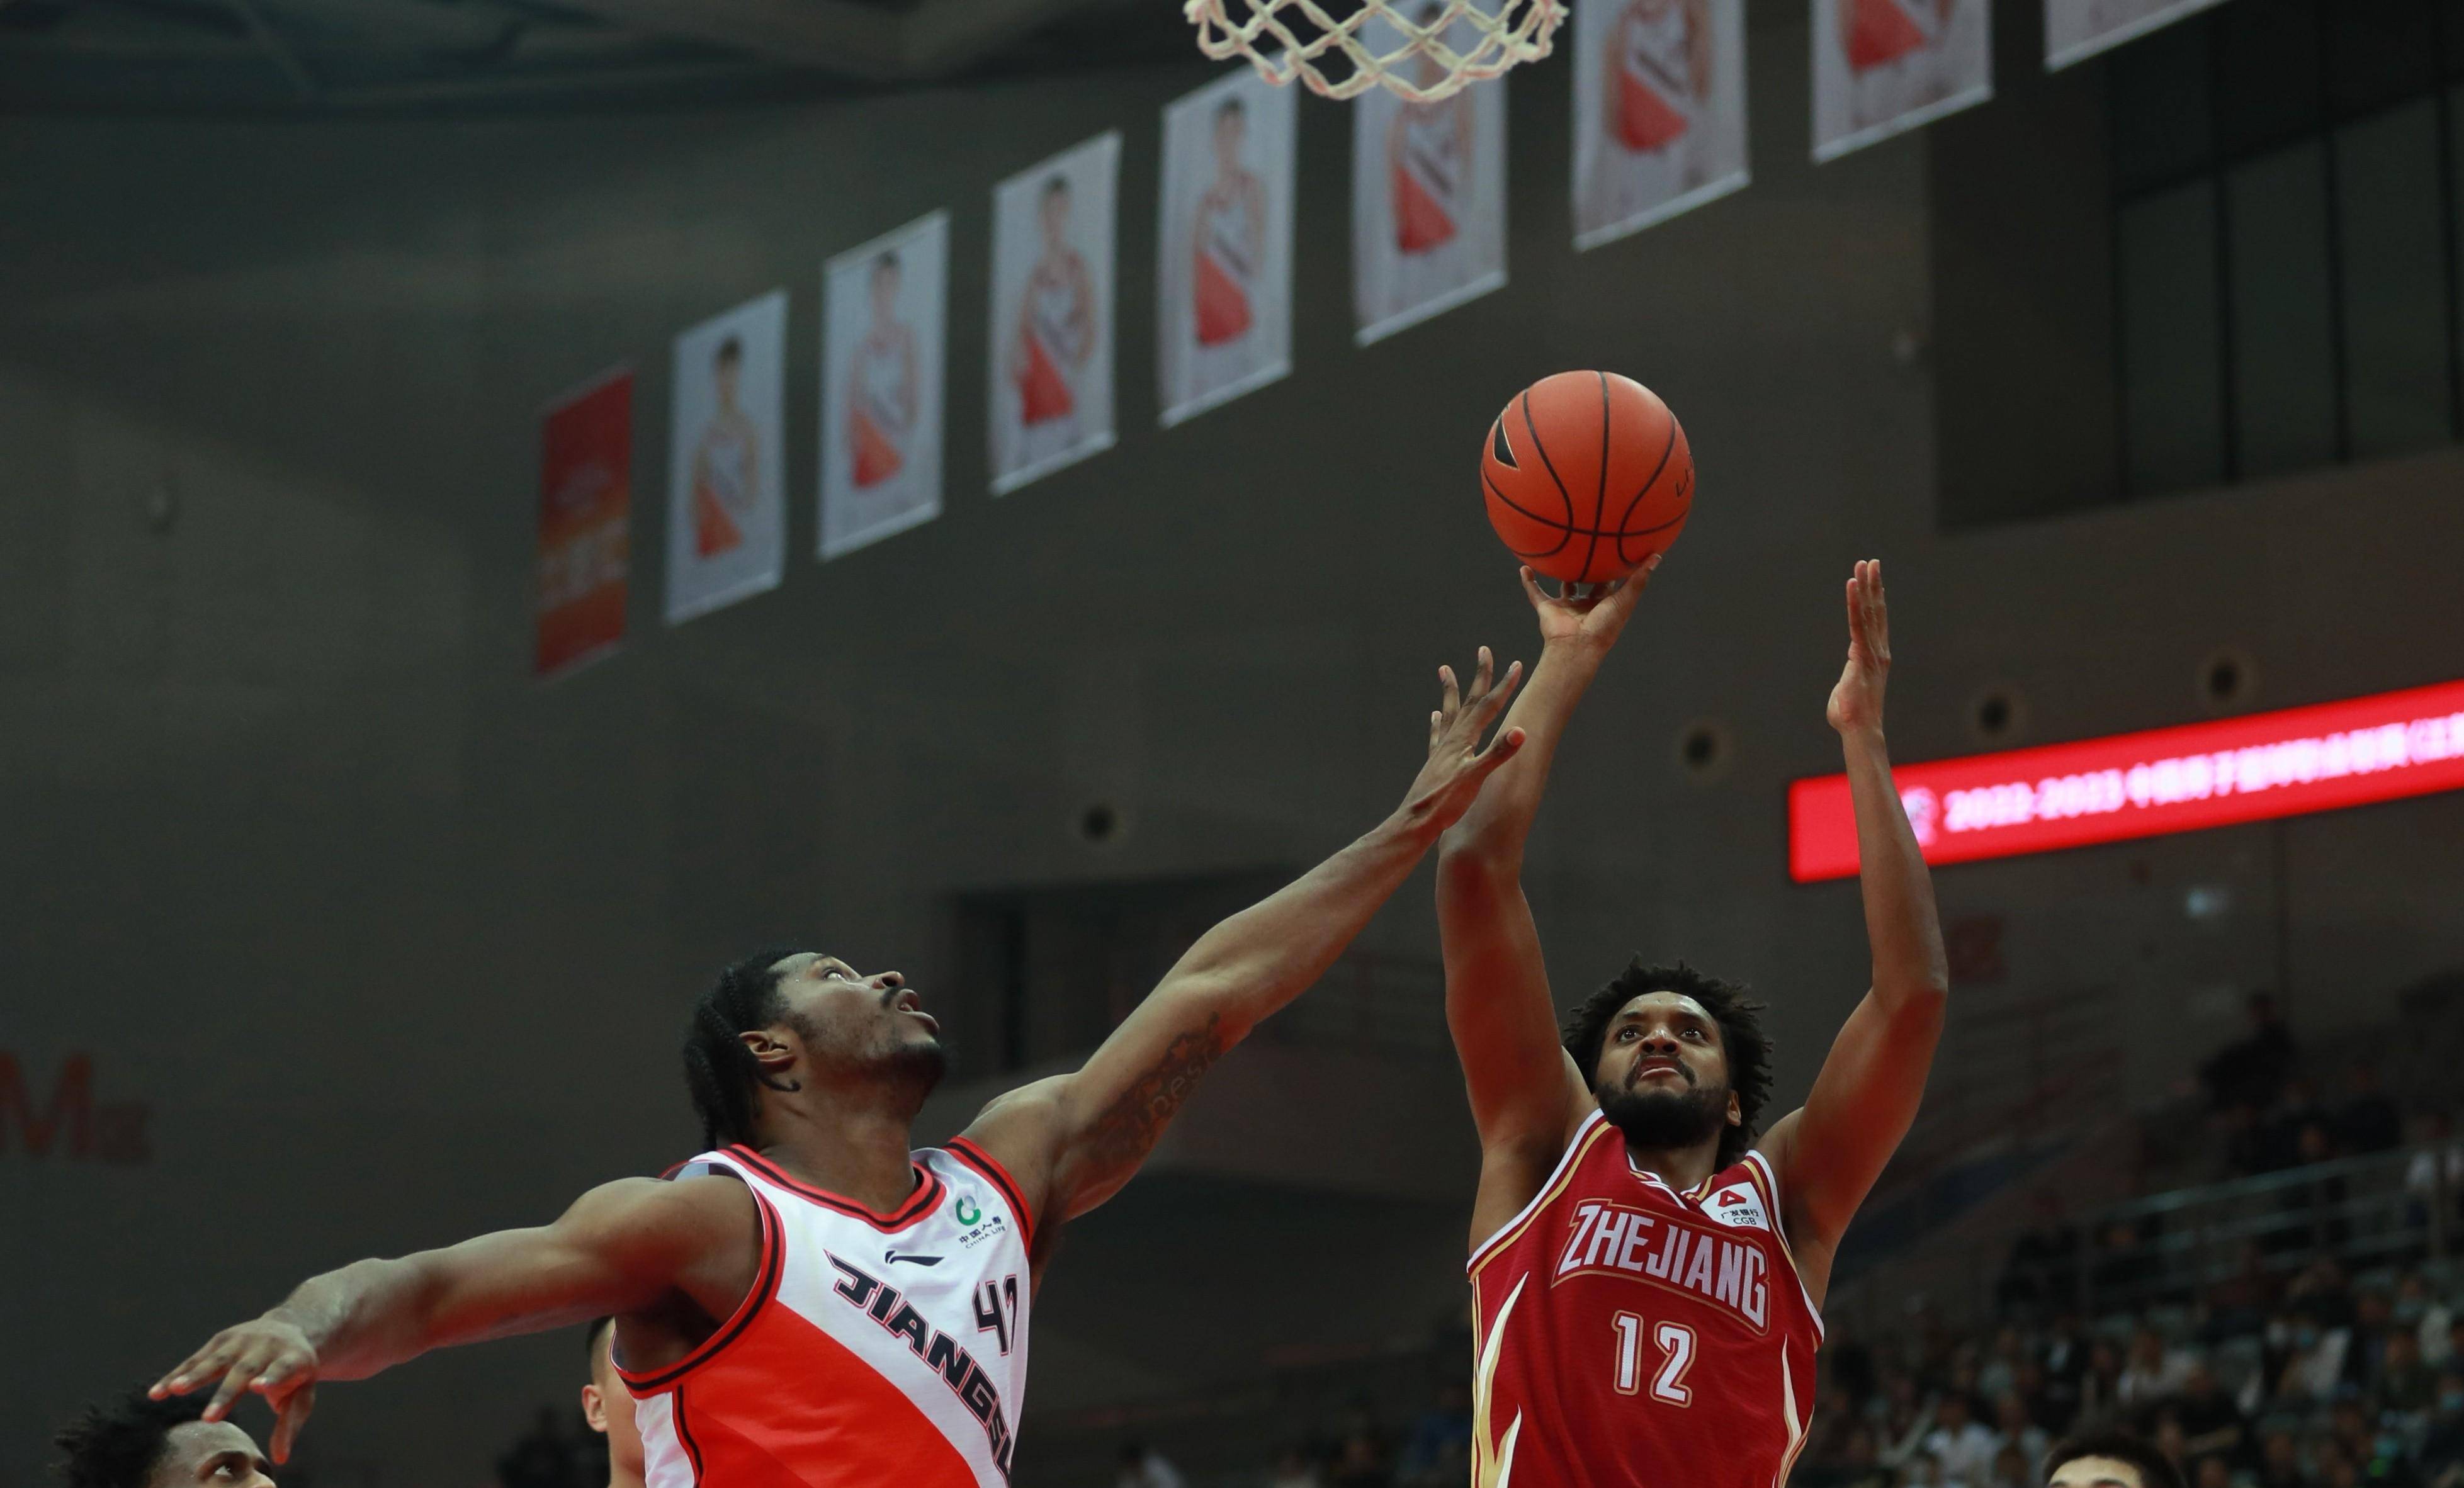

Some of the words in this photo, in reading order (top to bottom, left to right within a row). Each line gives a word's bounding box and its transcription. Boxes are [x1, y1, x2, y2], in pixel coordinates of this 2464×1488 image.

[1721, 1209, 1759, 1219] 广发银行
[959, 1215, 1002, 1243] 中国人寿
[966, 1233, 990, 1249] CHINA
[991, 1226, 1005, 1234] LIFE
[1557, 1204, 1767, 1329] ZHEJIANG
[1613, 1311, 1695, 1407] 12
